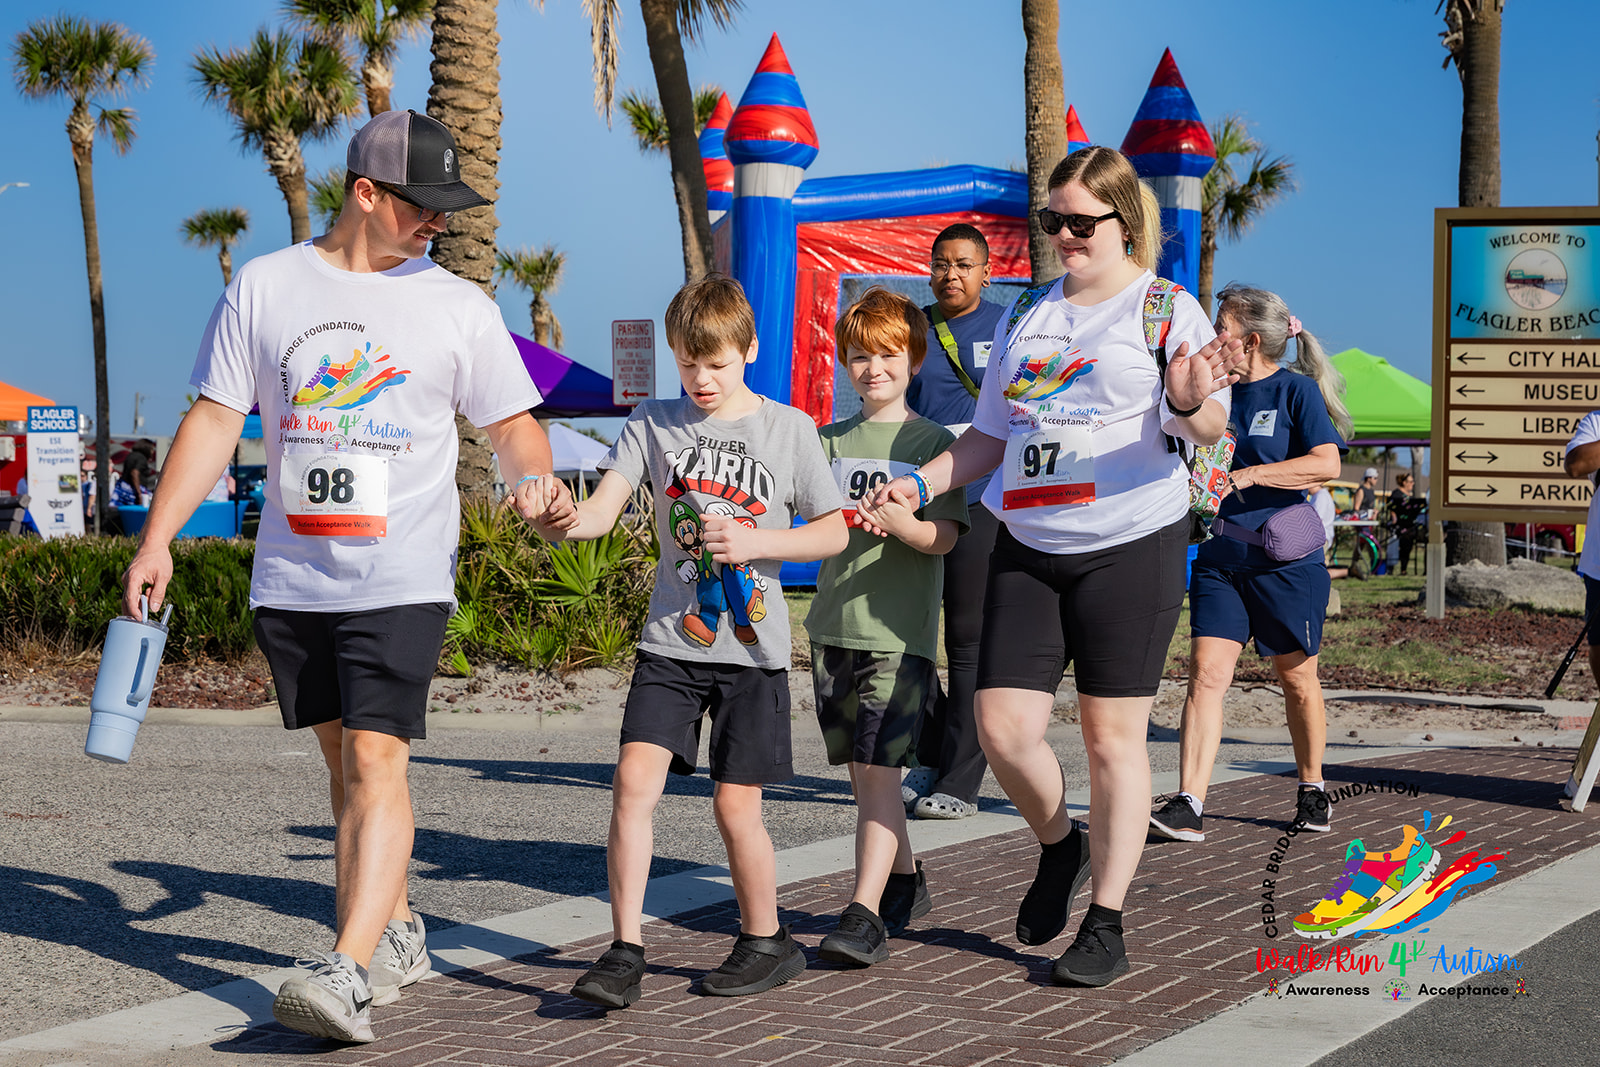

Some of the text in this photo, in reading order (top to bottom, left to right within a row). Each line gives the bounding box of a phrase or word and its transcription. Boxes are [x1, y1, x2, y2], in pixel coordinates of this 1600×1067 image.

[1489, 231, 1586, 249] WELCOME TO
[1454, 303, 1542, 332] FLAGLER
[618, 324, 649, 336] PARKING
[280, 335, 305, 369] BRIDGE
[304, 321, 366, 340] FOUNDATION
[615, 337, 652, 349] PROHIBITED
[1508, 351, 1555, 368] CITY
[1524, 384, 1598, 400] MUSEU
[31, 409, 75, 419] FLAGLER
[1041, 416, 1089, 426] Acceptance
[31, 420, 76, 430] SCHOOLS
[307, 414, 336, 433] Run
[362, 418, 415, 439] Autism
[36, 447, 75, 455] Transition
[351, 438, 401, 452] Acceptance
[699, 435, 748, 455] SUPER
[38, 457, 75, 465] Programs
[1024, 442, 1060, 478] 97
[307, 468, 354, 504] 98
[664, 447, 775, 513] MARIO
[1030, 491, 1063, 500] Acceptance
[316, 521, 352, 529] Acceptance
